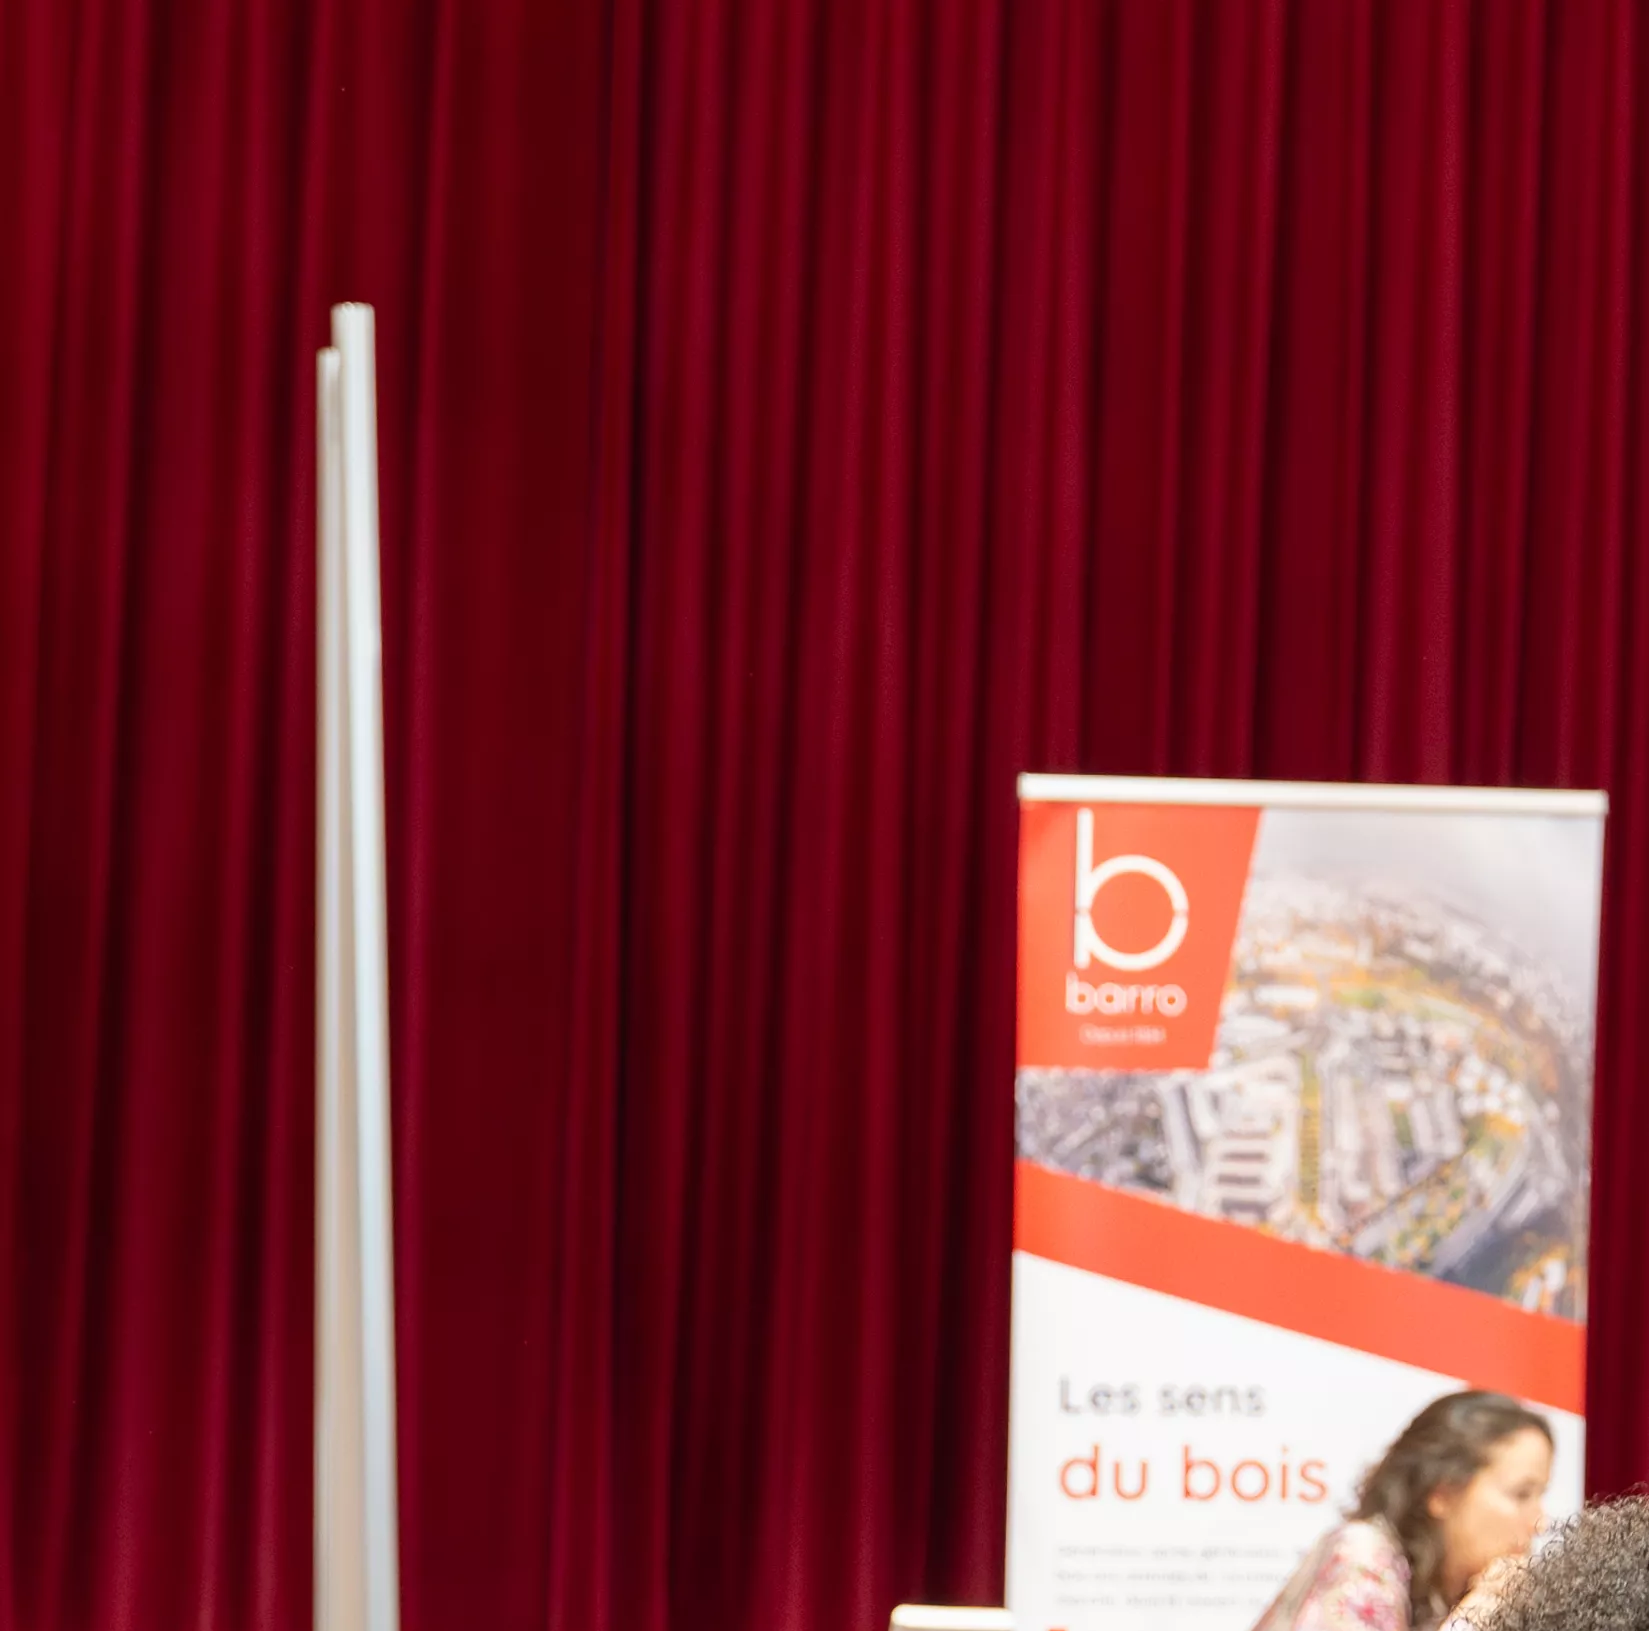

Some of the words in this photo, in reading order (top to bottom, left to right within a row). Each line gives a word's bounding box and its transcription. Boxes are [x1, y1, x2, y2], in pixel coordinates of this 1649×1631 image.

[1074, 807, 1189, 971] b
[1065, 970, 1187, 1017] barro
[1058, 1375, 1142, 1416] Les
[1158, 1382, 1267, 1417] sens
[1058, 1443, 1150, 1501] du
[1182, 1443, 1330, 1502] bois
